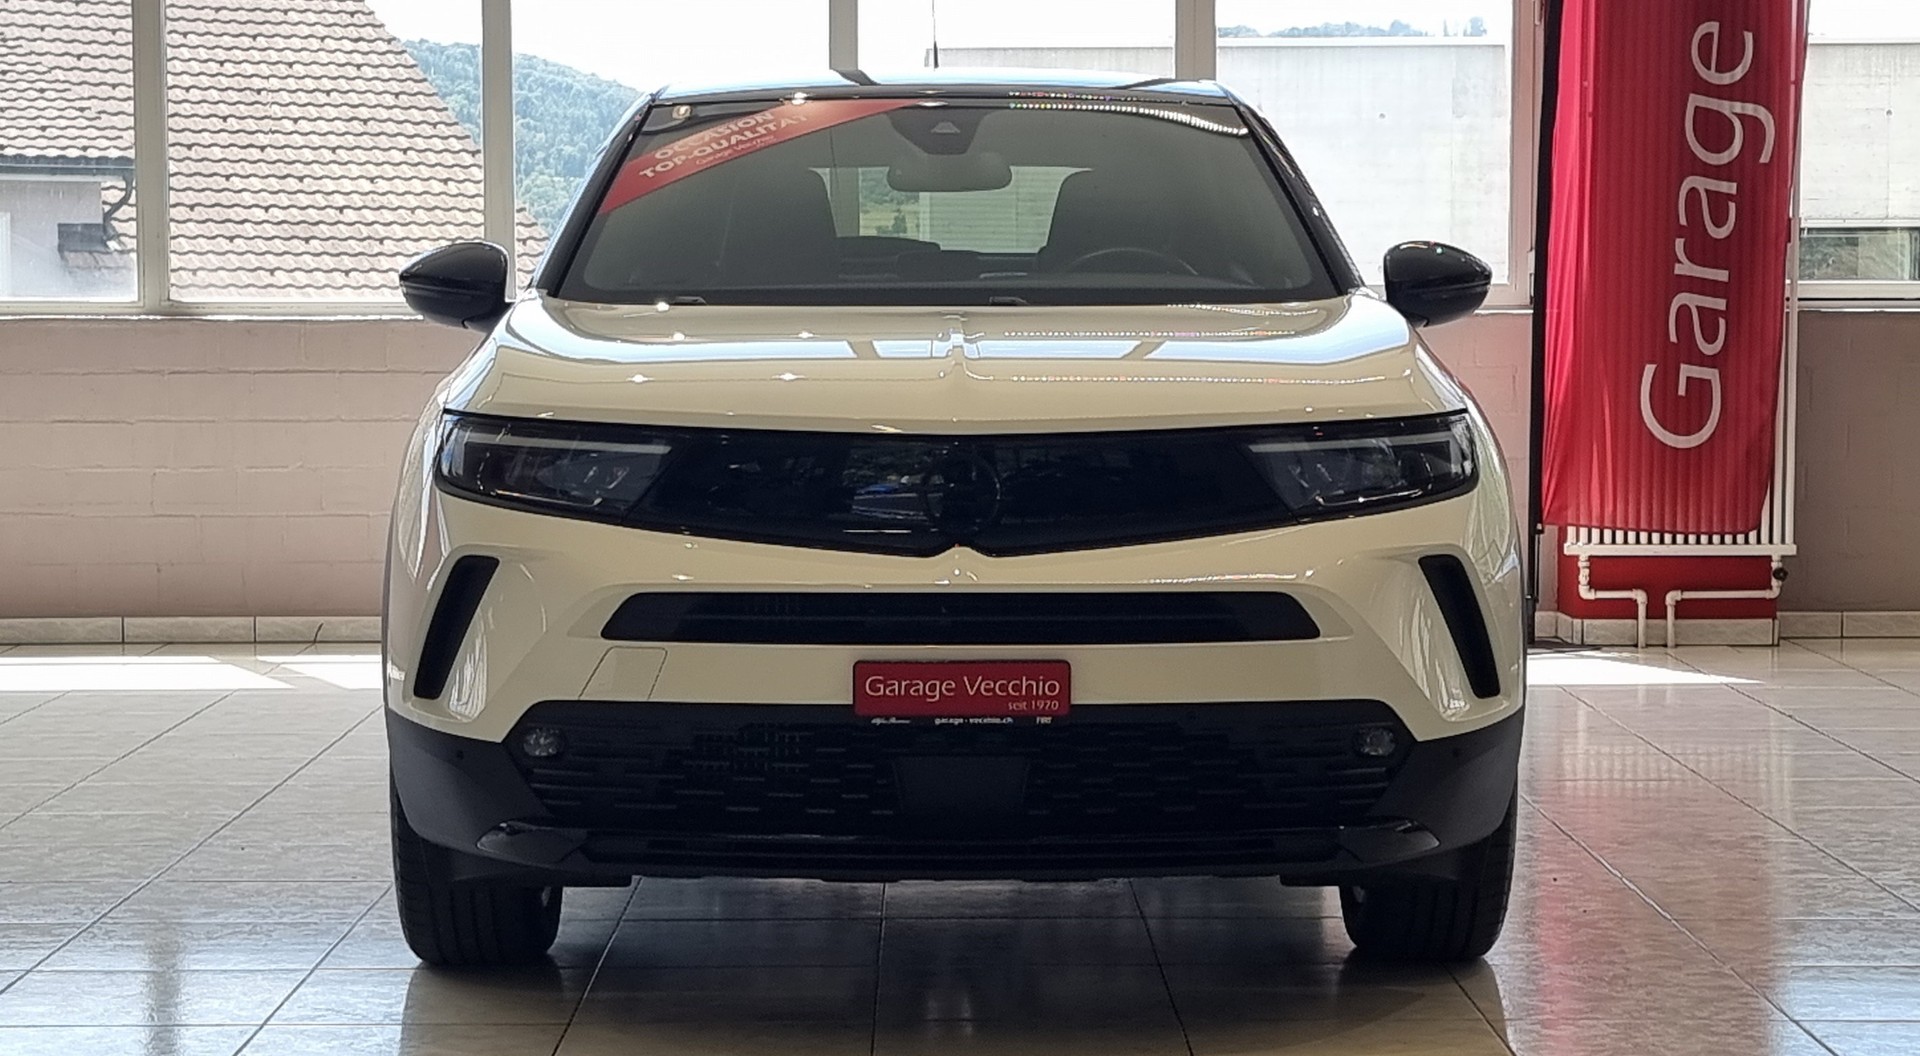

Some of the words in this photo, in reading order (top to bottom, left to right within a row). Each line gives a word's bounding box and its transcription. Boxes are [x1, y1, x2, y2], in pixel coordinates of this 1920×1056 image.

[653, 110, 775, 160] OCCASION
[1640, 20, 1776, 450] Garage
[865, 676, 956, 702] Garage
[963, 676, 1060, 696] Vecchio
[1007, 701, 1028, 711] seit
[1031, 700, 1060, 711] 1970
